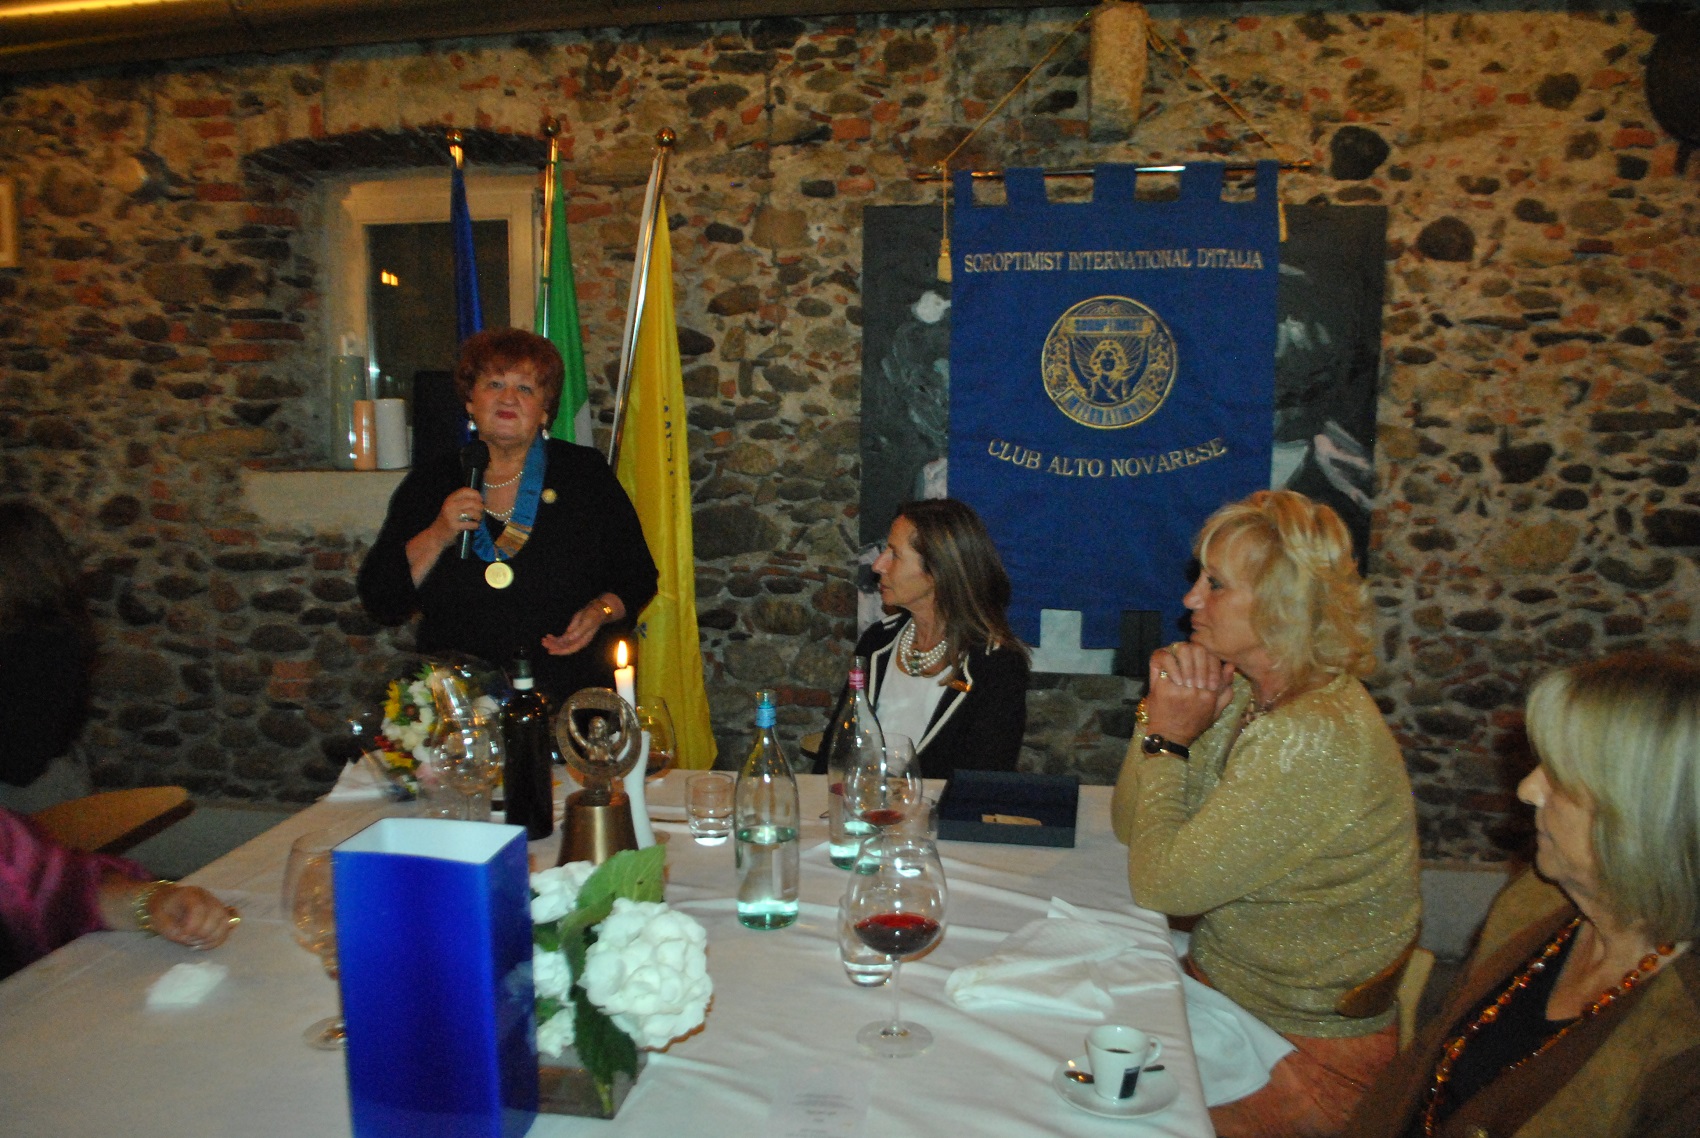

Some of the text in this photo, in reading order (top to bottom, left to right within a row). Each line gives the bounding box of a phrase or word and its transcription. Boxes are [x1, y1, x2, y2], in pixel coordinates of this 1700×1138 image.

[964, 248, 1265, 272] SOROPTIMIST INTERNATIONAL D'ITALIA
[988, 437, 1228, 478] CLUB ALTO NOVARESE
